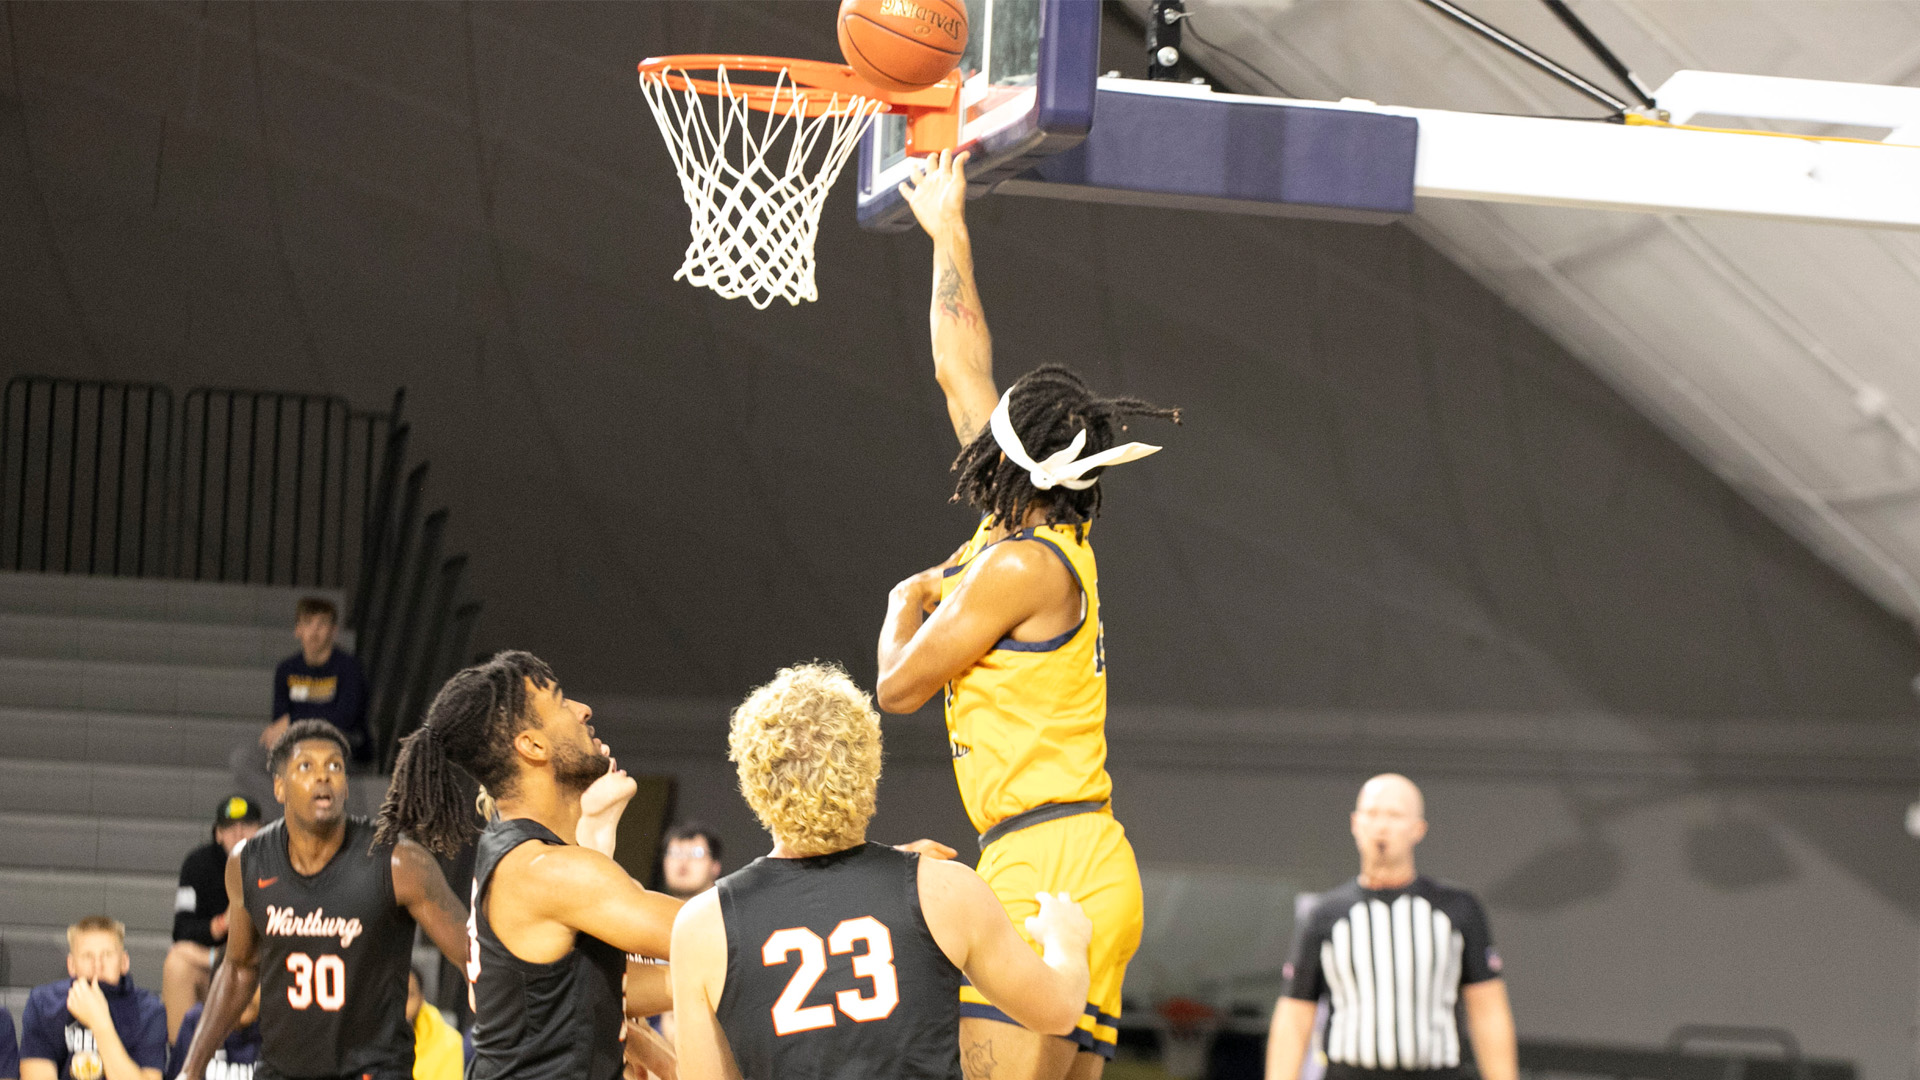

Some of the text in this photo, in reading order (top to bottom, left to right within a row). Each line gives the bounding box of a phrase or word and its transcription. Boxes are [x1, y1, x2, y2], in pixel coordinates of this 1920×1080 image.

[265, 904, 363, 949] Wartburg
[286, 952, 346, 1011] 30
[761, 915, 899, 1037] 23
